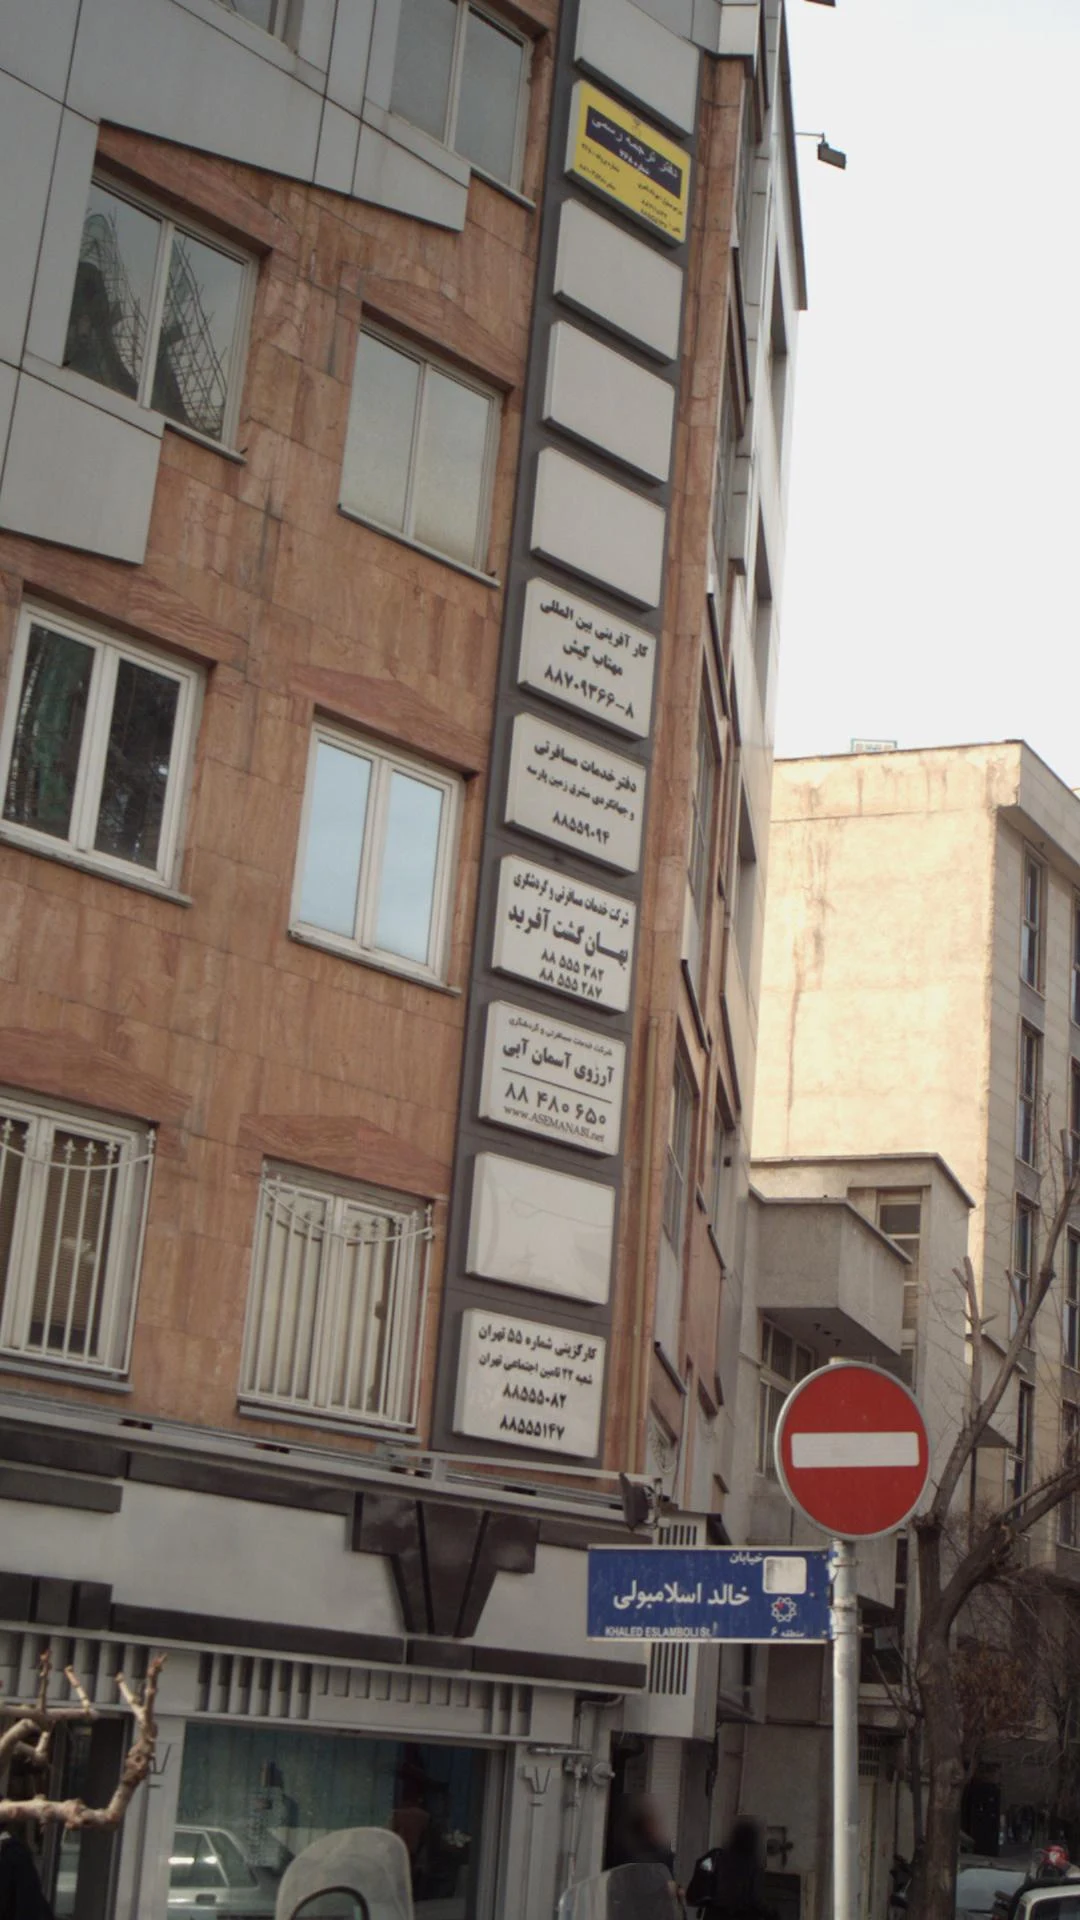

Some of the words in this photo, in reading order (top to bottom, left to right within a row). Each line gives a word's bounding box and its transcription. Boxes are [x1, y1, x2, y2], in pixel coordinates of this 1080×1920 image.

[540, 600, 574, 620] المللی
[575, 617, 593, 633] بین
[594, 627, 631, 648] آفرینی
[562, 639, 591, 660] کیش
[592, 654, 624, 676] مهتاب
[534, 740, 579, 766] مسافرتی
[580, 759, 616, 782] خدمات
[615, 775, 637, 792] دفتر
[513, 872, 548, 896] گردشگری
[548, 888, 554, 900] و
[554, 886, 583, 906] مسافرتی
[584, 898, 608, 916] خدمات
[508, 904, 551, 934] آفرید
[609, 908, 630, 928] شرکت
[552, 920, 585, 944] گشت
[541, 948, 556, 964] ۸۸
[559, 955, 580, 974] ۵۵۵
[539, 967, 554, 983] ۸۸
[557, 973, 579, 992] ۵۵۵
[502, 1037, 530, 1059] آبی
[531, 1047, 573, 1069] آسمان
[573, 1065, 615, 1087] آرزوی
[505, 1081, 529, 1104] ۸۸
[537, 1090, 570, 1113] ۴۸۰
[575, 1103, 607, 1125] ۶۵۰
[478, 1324, 506, 1342] تهران
[507, 1328, 523, 1345] ۵۵
[525, 1334, 552, 1351] شماره
[478, 1352, 503, 1368] تهران
[503, 1358, 538, 1375] اجتماعی
[575, 1373, 593, 1387] شعبه
[729, 1551, 763, 1566] خیابان
[613, 1579, 703, 1610] اسلامبولی
[707, 1583, 750, 1606] خالد
[604, 1625, 644, 1638] KHALED
[644, 1625, 699, 1638] ESLAMBOLI
